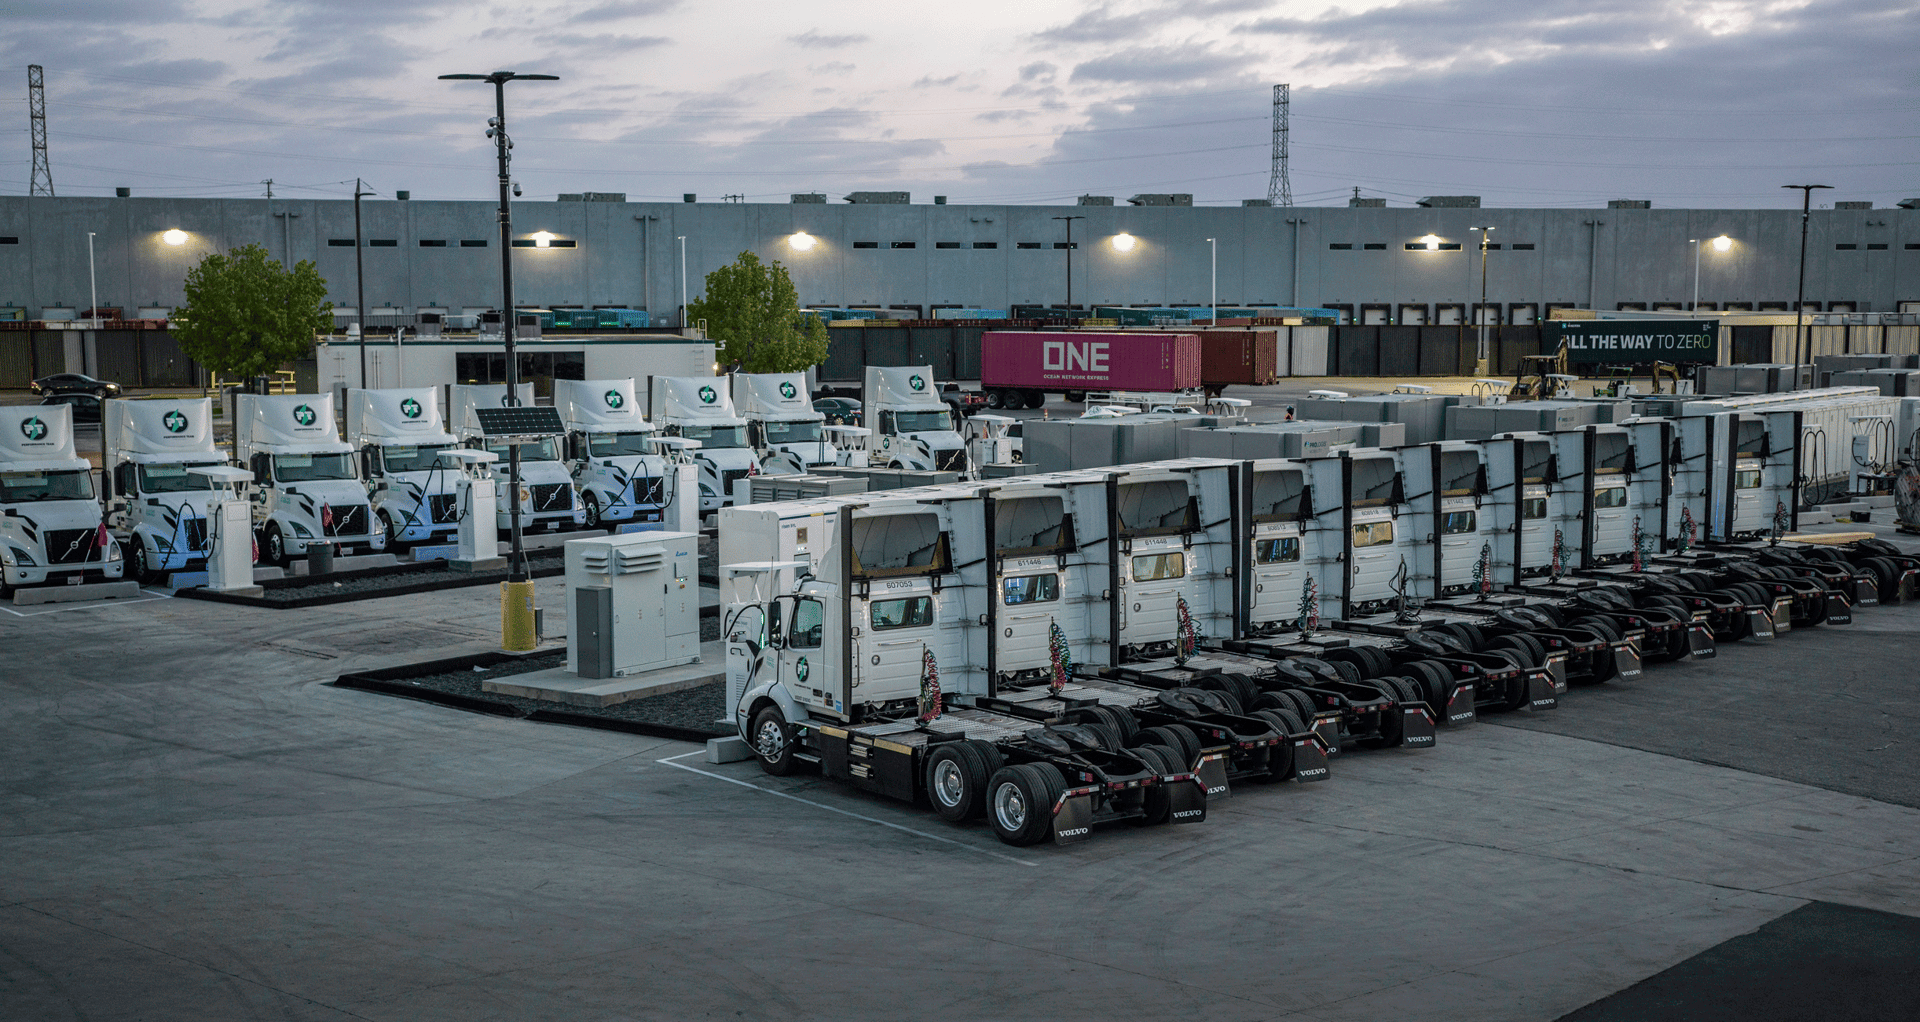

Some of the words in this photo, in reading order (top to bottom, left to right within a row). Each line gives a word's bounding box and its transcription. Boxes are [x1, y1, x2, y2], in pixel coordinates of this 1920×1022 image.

[1590, 335, 1619, 350] THE
[1620, 335, 1655, 350] WAY
[1656, 334, 1677, 350] TO
[1677, 334, 1712, 350] ZERO
[1043, 341, 1110, 372] ONE
[886, 580, 913, 590] 607053
[1693, 648, 1713, 656] VOLVO
[1533, 698, 1555, 706] VOLVO
[1450, 711, 1473, 721] VOLVO
[1407, 735, 1433, 743] VOLVO
[1299, 767, 1327, 777] VOLVO
[1172, 809, 1202, 819] VOLVO
[1058, 827, 1089, 838] VOLVO
